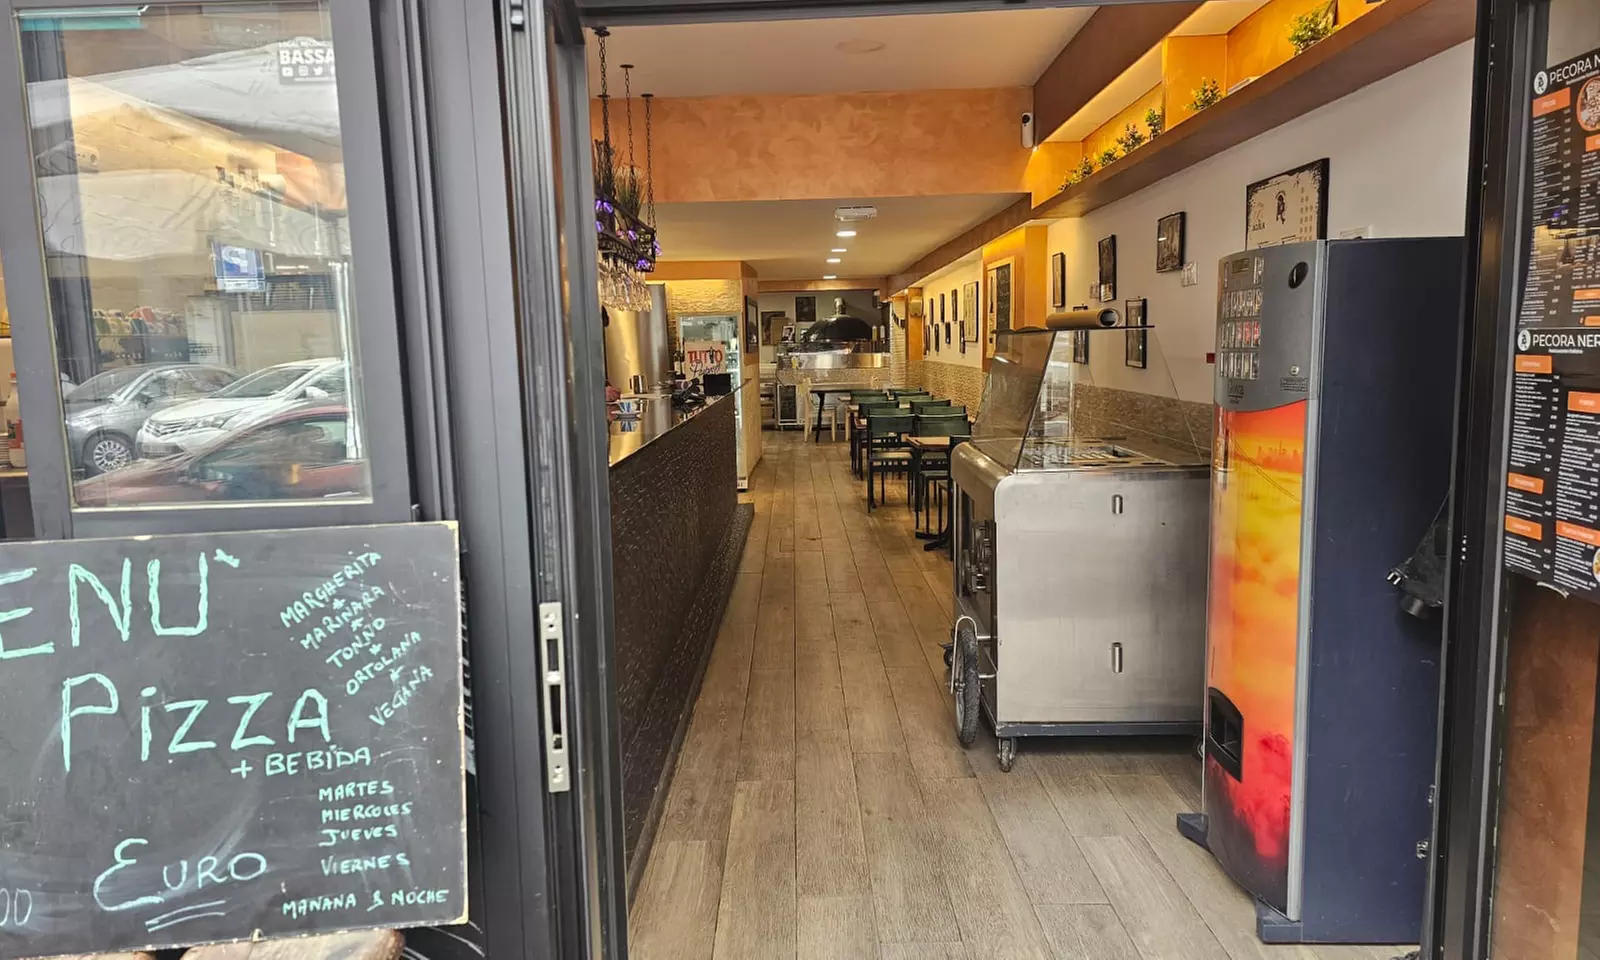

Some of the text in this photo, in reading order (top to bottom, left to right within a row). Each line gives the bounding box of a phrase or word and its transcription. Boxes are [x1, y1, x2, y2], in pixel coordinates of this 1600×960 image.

[1549, 57, 1592, 85] PECORA
[1532, 333, 1576, 347] PECORA
[280, 552, 382, 628] MARGHERITA
[300, 586, 385, 649] MARINARA
[326, 617, 385, 668] TONNO
[346, 631, 422, 695] ORTOLANA
[369, 665, 433, 726] VEGANA
[319, 780, 394, 802] MARTES
[321, 802, 413, 824] MIERCOLES
[318, 824, 398, 847] JUEVES
[320, 853, 410, 876] VIERNES
[391, 889, 450, 907] NOCHE
